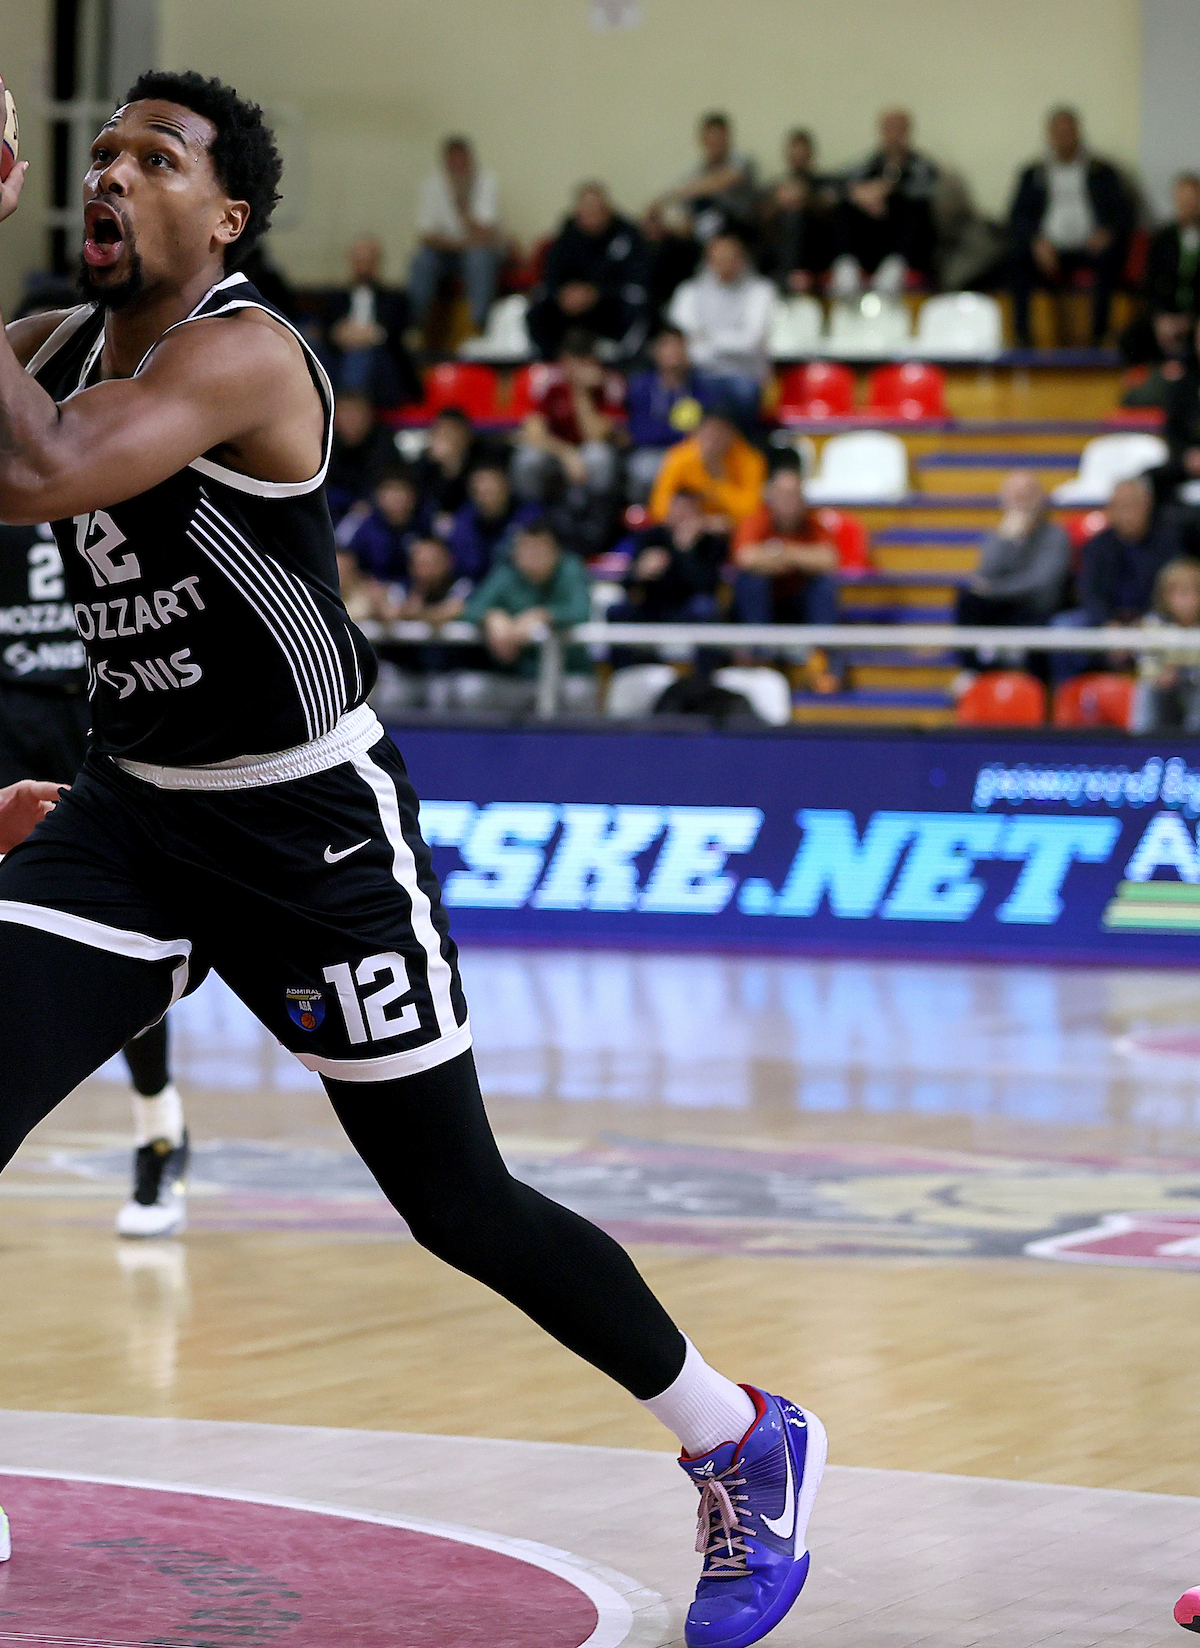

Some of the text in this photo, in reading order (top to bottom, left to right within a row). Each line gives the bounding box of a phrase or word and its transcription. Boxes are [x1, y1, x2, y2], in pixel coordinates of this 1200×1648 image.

[73, 509, 141, 587] 12
[74, 576, 206, 640] OZZART
[322, 951, 421, 1044] 12
